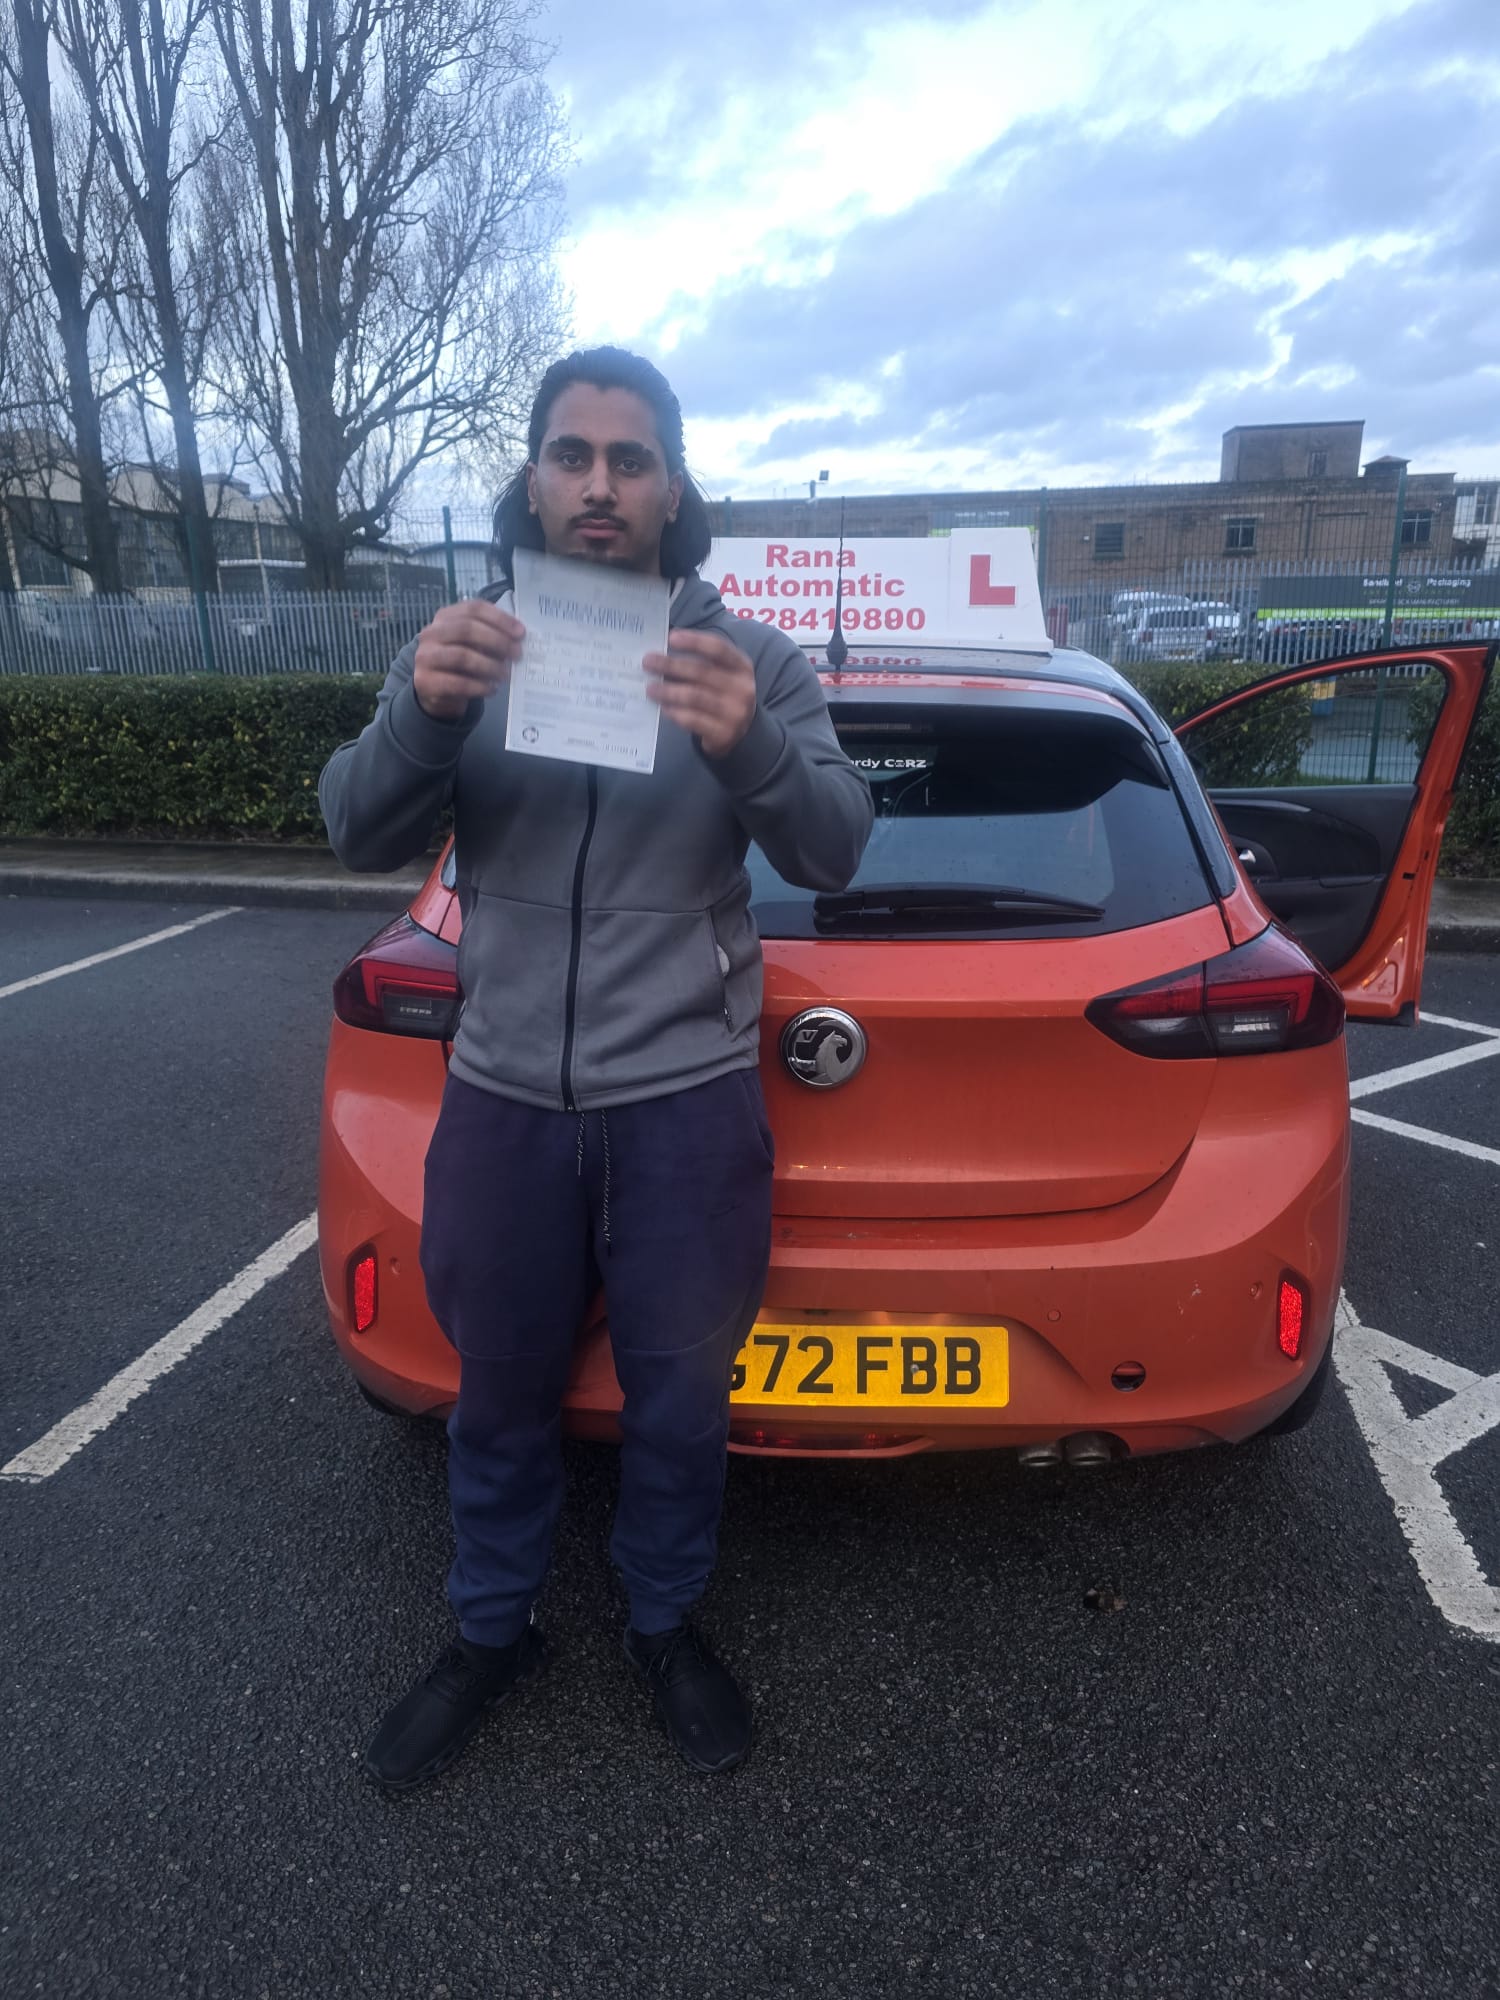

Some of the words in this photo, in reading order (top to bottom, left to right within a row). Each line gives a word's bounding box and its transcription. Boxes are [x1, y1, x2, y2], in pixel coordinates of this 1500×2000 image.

[765, 544, 856, 568] Rana
[719, 573, 905, 597] Automatic
[969, 554, 1016, 605] L
[856, 1336, 981, 1395] FBB
